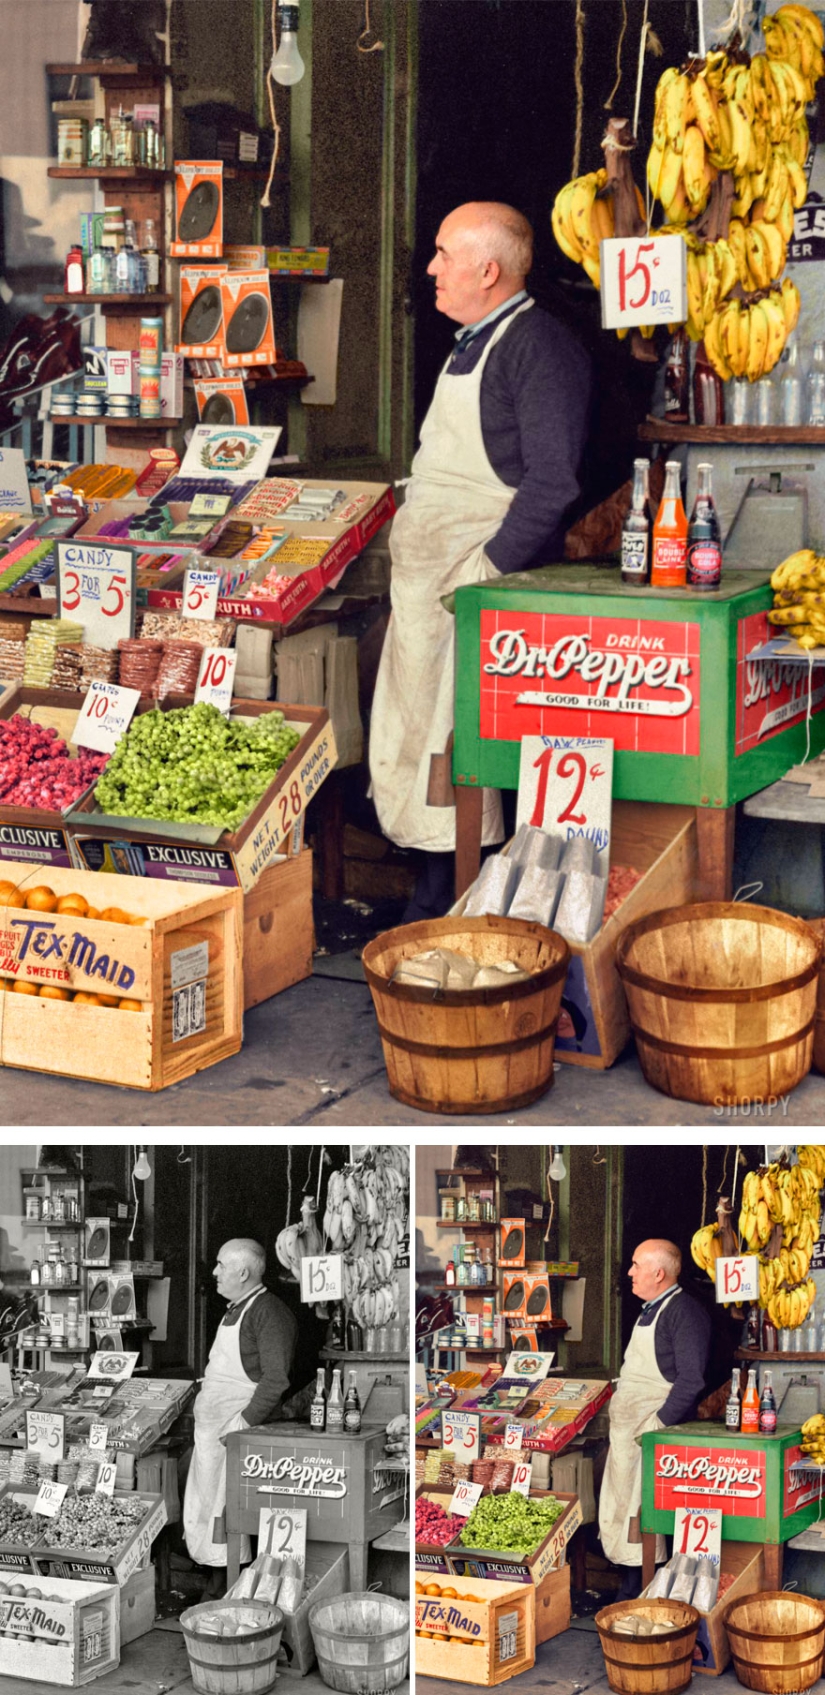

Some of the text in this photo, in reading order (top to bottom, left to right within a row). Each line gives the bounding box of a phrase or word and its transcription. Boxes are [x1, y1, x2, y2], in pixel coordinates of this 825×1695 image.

[65, 548, 113, 566] CANDY
[62, 571, 81, 610] 3
[81, 573, 100, 594] FOR
[606, 633, 665, 650] DRINK
[546, 694, 580, 705] GOOD
[588, 697, 611, 708] FOR
[300, 737, 329, 782] POUNDS
[278, 780, 302, 834] 28
[0, 827, 61, 848] CLUSIVE
[252, 820, 270, 849] NET
[146, 845, 228, 869] EXCLUSIVE
[250, 828, 280, 876] WEIGHT
[26, 965, 71, 981] SWEETER
[445, 1413, 470, 1423] CANDY
[28, 1424, 38, 1445] 3
[444, 1424, 454, 1445] 3
[303, 1455, 333, 1465] DRINK
[718, 1456, 749, 1465] DRINK
[137, 1529, 150, 1558] 28
[553, 1530, 566, 1558] 28
[70, 1562, 113, 1575] EXCLUSIVE
[486, 1562, 528, 1575] EXCLUSIVE
